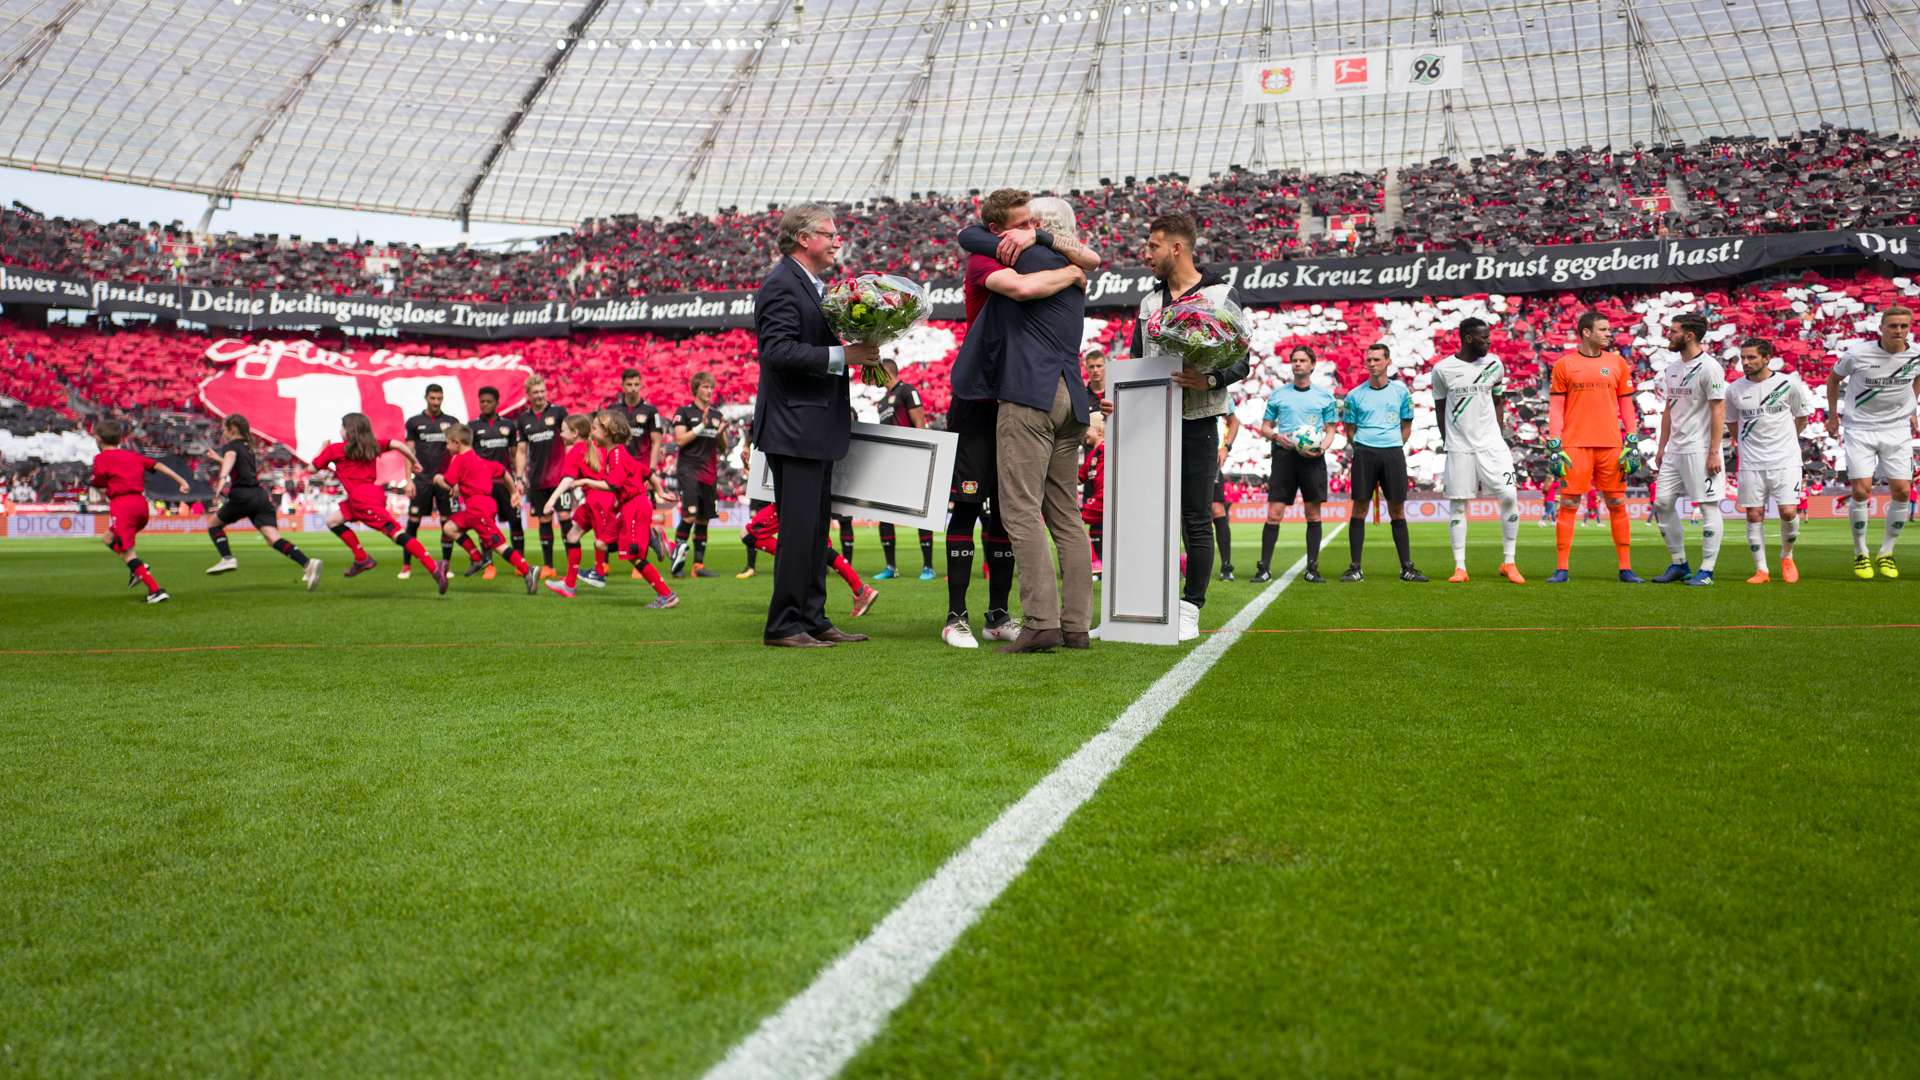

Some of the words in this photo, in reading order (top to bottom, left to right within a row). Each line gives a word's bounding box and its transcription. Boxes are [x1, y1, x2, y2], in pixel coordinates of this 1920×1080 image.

[1414, 59, 1441, 81] 96
[1856, 232, 1908, 254] Du
[92, 281, 182, 309] finden.
[188, 289, 265, 316] Deine
[269, 292, 447, 328] bedingungslose
[451, 304, 508, 327] Treue
[512, 303, 551, 325] und
[554, 298, 648, 323] Loyalität
[651, 296, 725, 320] werden
[1091, 271, 1134, 300] für
[1243, 264, 1289, 290] das
[1293, 264, 1373, 288] Kreuz
[1377, 257, 1426, 288] auf
[1427, 256, 1472, 281] der
[1474, 254, 1550, 280] Brust
[1550, 247, 1660, 283] gegeben
[1667, 239, 1743, 266] hast!
[1705, 478, 1714, 493] 2
